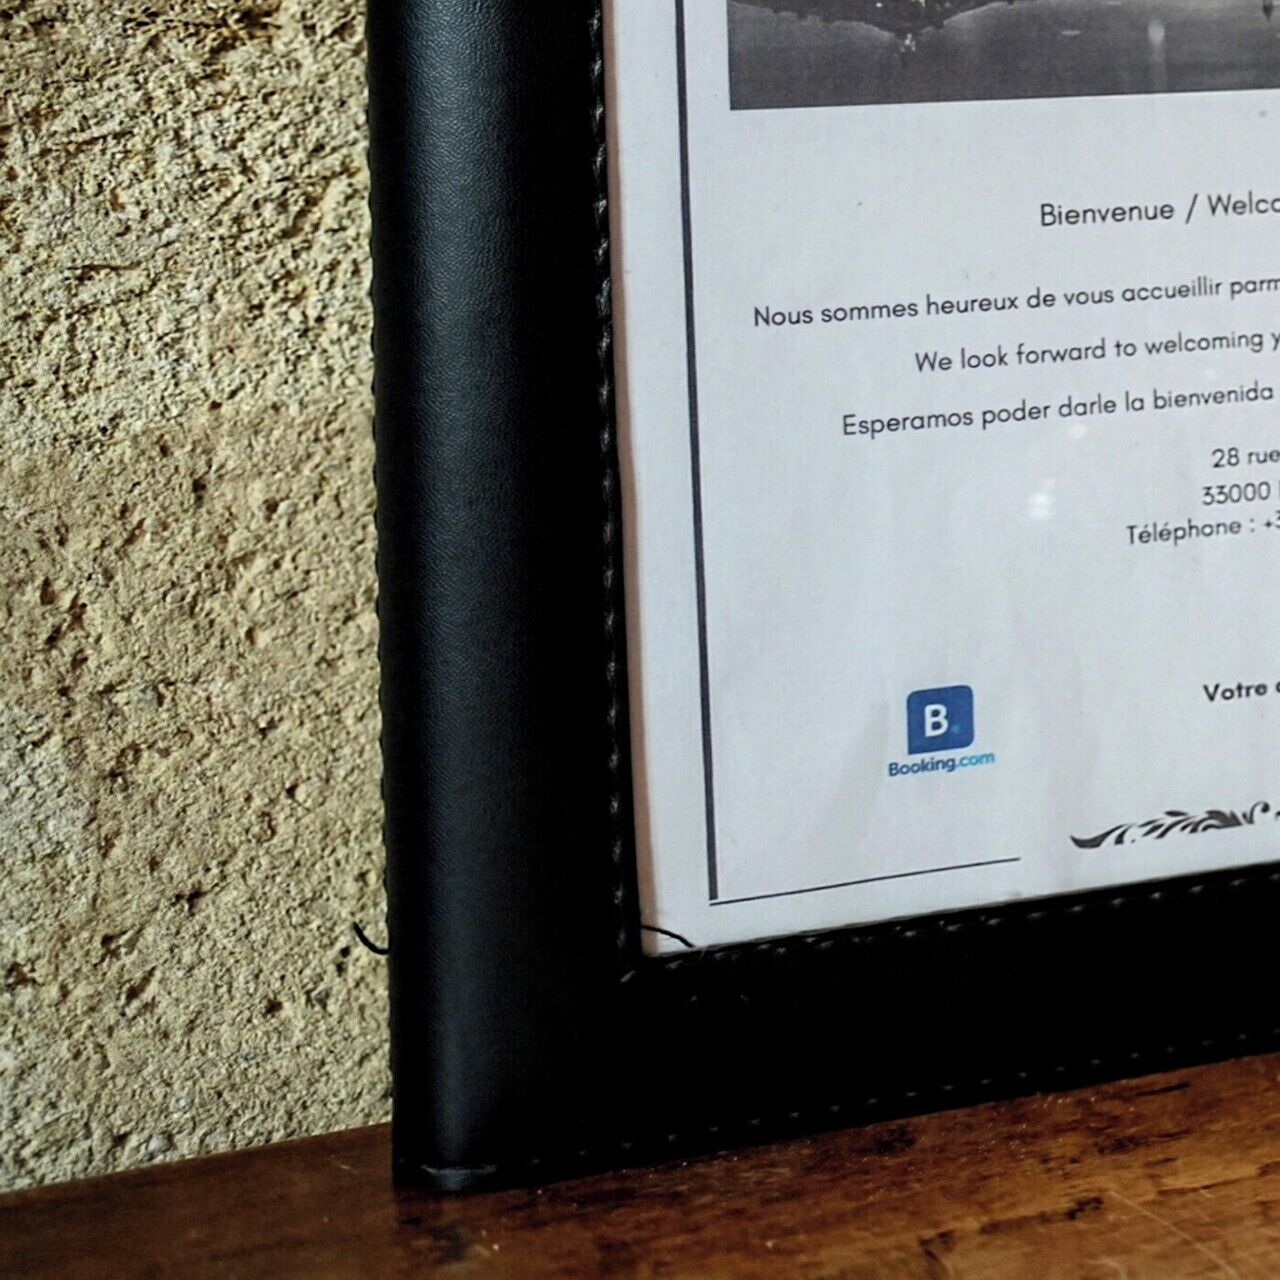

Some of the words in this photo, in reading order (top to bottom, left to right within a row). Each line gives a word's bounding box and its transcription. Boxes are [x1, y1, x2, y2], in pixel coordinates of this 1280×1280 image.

[1040, 202, 1175, 227] Bienvenue
[754, 305, 813, 327] Nous
[821, 303, 919, 324] sommes
[926, 294, 1019, 316] heureux
[1026, 287, 1056, 309] de
[1063, 291, 1114, 307] vous
[1121, 276, 1222, 302] accueillir
[915, 351, 952, 373] We
[960, 344, 1008, 369] look
[1016, 337, 1106, 365] forward
[1115, 339, 1136, 358] to
[1145, 331, 1264, 357] welcoming
[842, 413, 974, 440] Esperamos
[982, 399, 1050, 430] poder
[1058, 393, 1116, 418] darle
[1125, 390, 1145, 412] la
[1153, 385, 1274, 411] bienvenida
[1212, 447, 1240, 468] 28
[1247, 449, 1280, 465] rue
[1202, 481, 1271, 507] 33000
[1126, 518, 1242, 546] Téléphone
[1203, 681, 1268, 702] Votre
[887, 752, 996, 777] Booking.com
